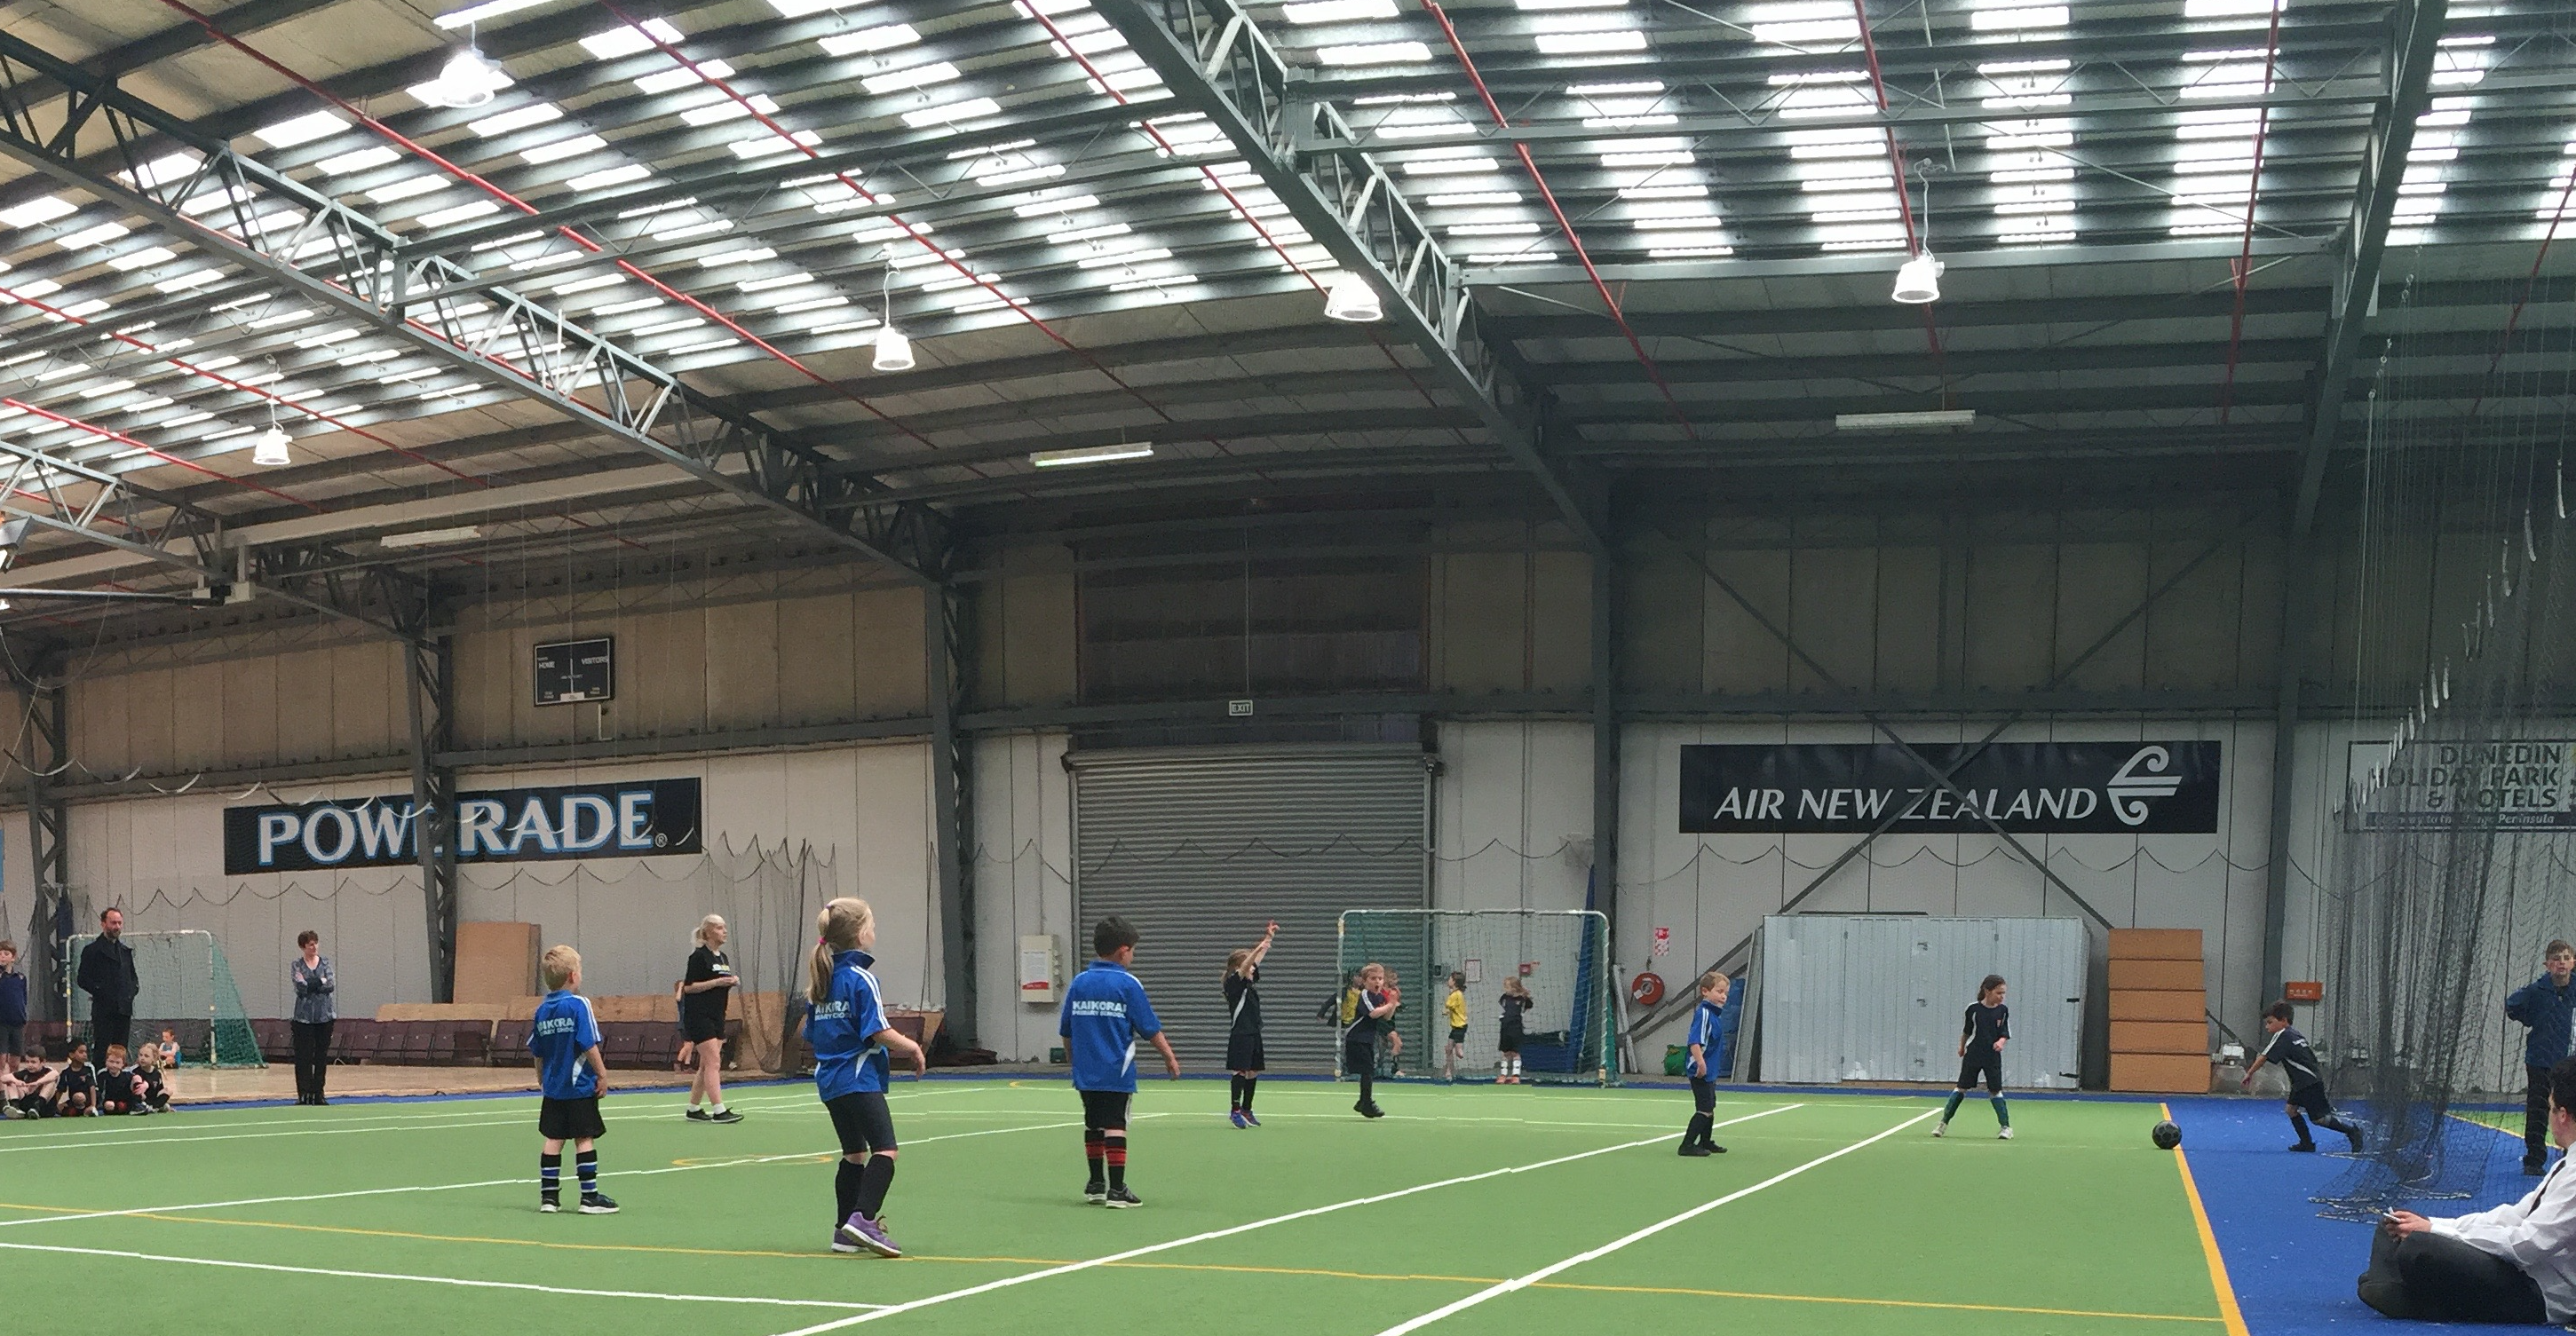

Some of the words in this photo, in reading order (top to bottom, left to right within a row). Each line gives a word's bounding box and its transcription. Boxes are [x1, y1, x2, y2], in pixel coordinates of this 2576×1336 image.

[2440, 745, 2561, 764] DUNEDIN
[2490, 767, 2559, 787] PARK
[1713, 787, 1785, 819] AIR
[1796, 788, 1893, 819] NEW
[1899, 787, 2097, 820] ZEALAND
[2427, 790, 2445, 808] &
